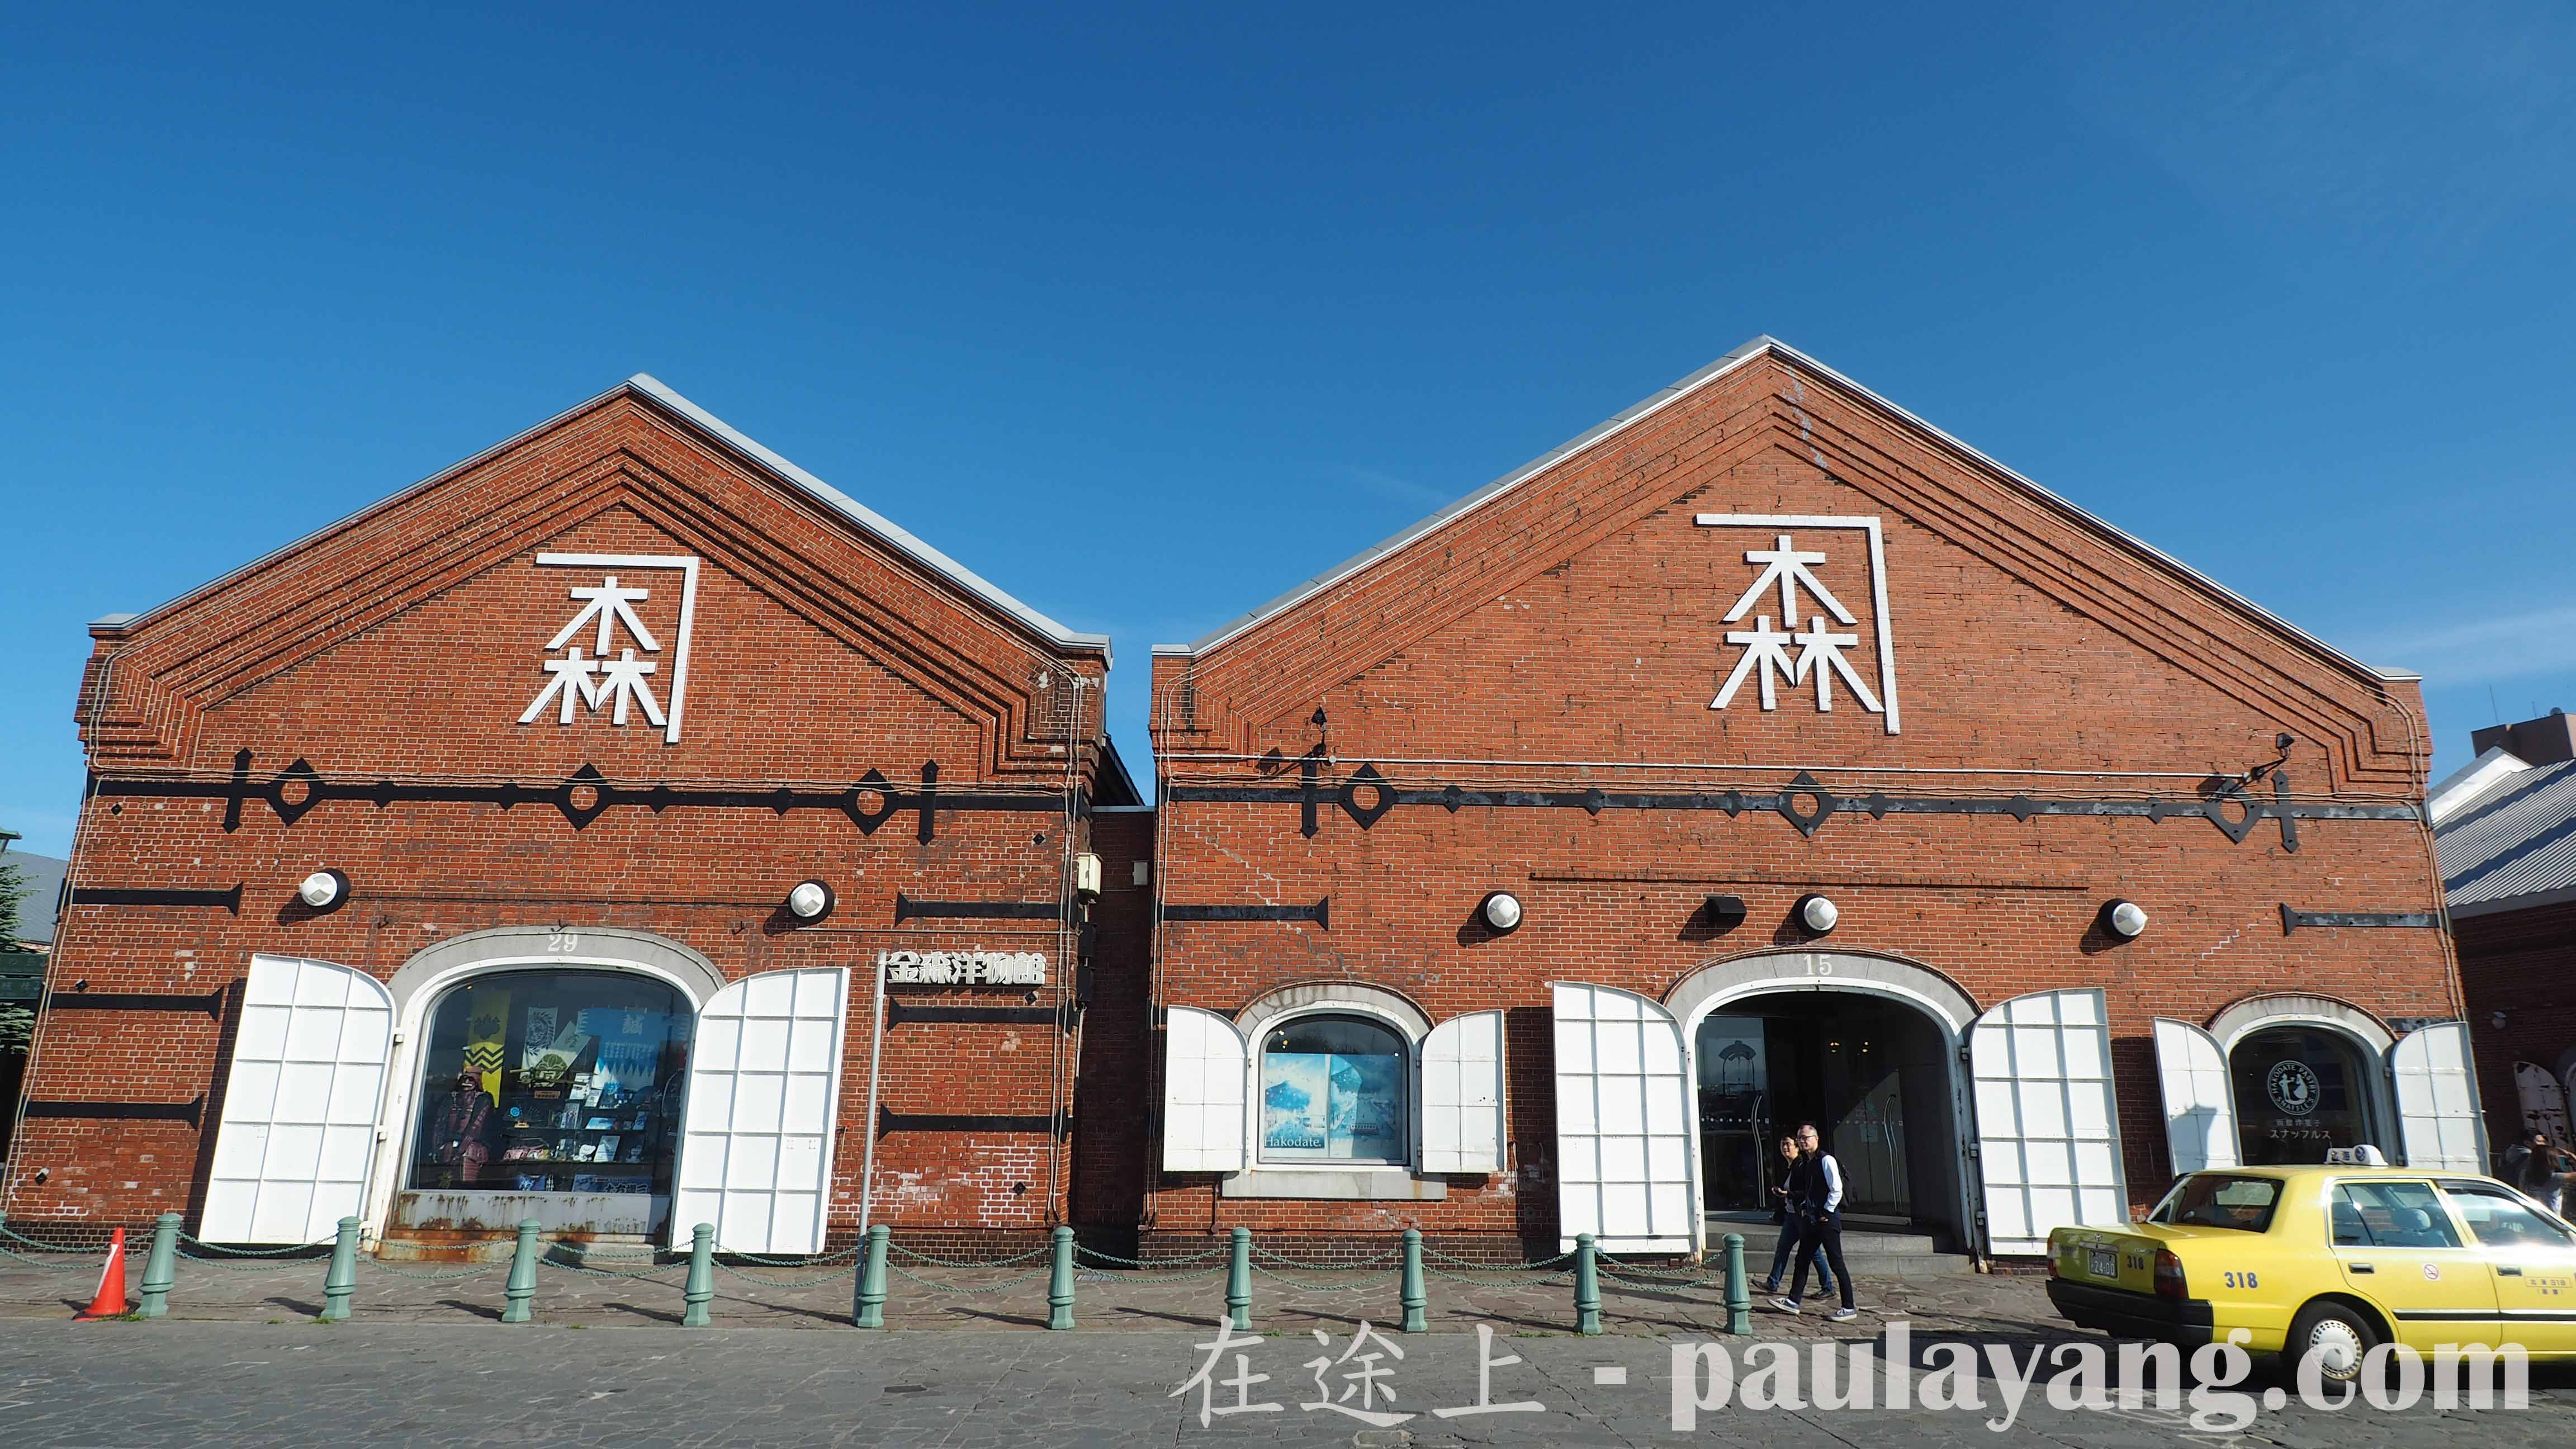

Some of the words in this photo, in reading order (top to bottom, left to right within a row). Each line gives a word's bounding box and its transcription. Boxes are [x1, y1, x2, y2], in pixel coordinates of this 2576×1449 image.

[547, 933, 578, 953] 29
[887, 951, 1046, 985] 金森洋物館
[1803, 954, 1832, 976] 15
[2271, 1064, 2296, 1094] HAKODATE
[2298, 1068, 2317, 1094] PASTRY
[1264, 1135, 1322, 1148] Hakodate.
[2127, 1255, 2144, 1271] 318
[2224, 1272, 2258, 1289] 318
